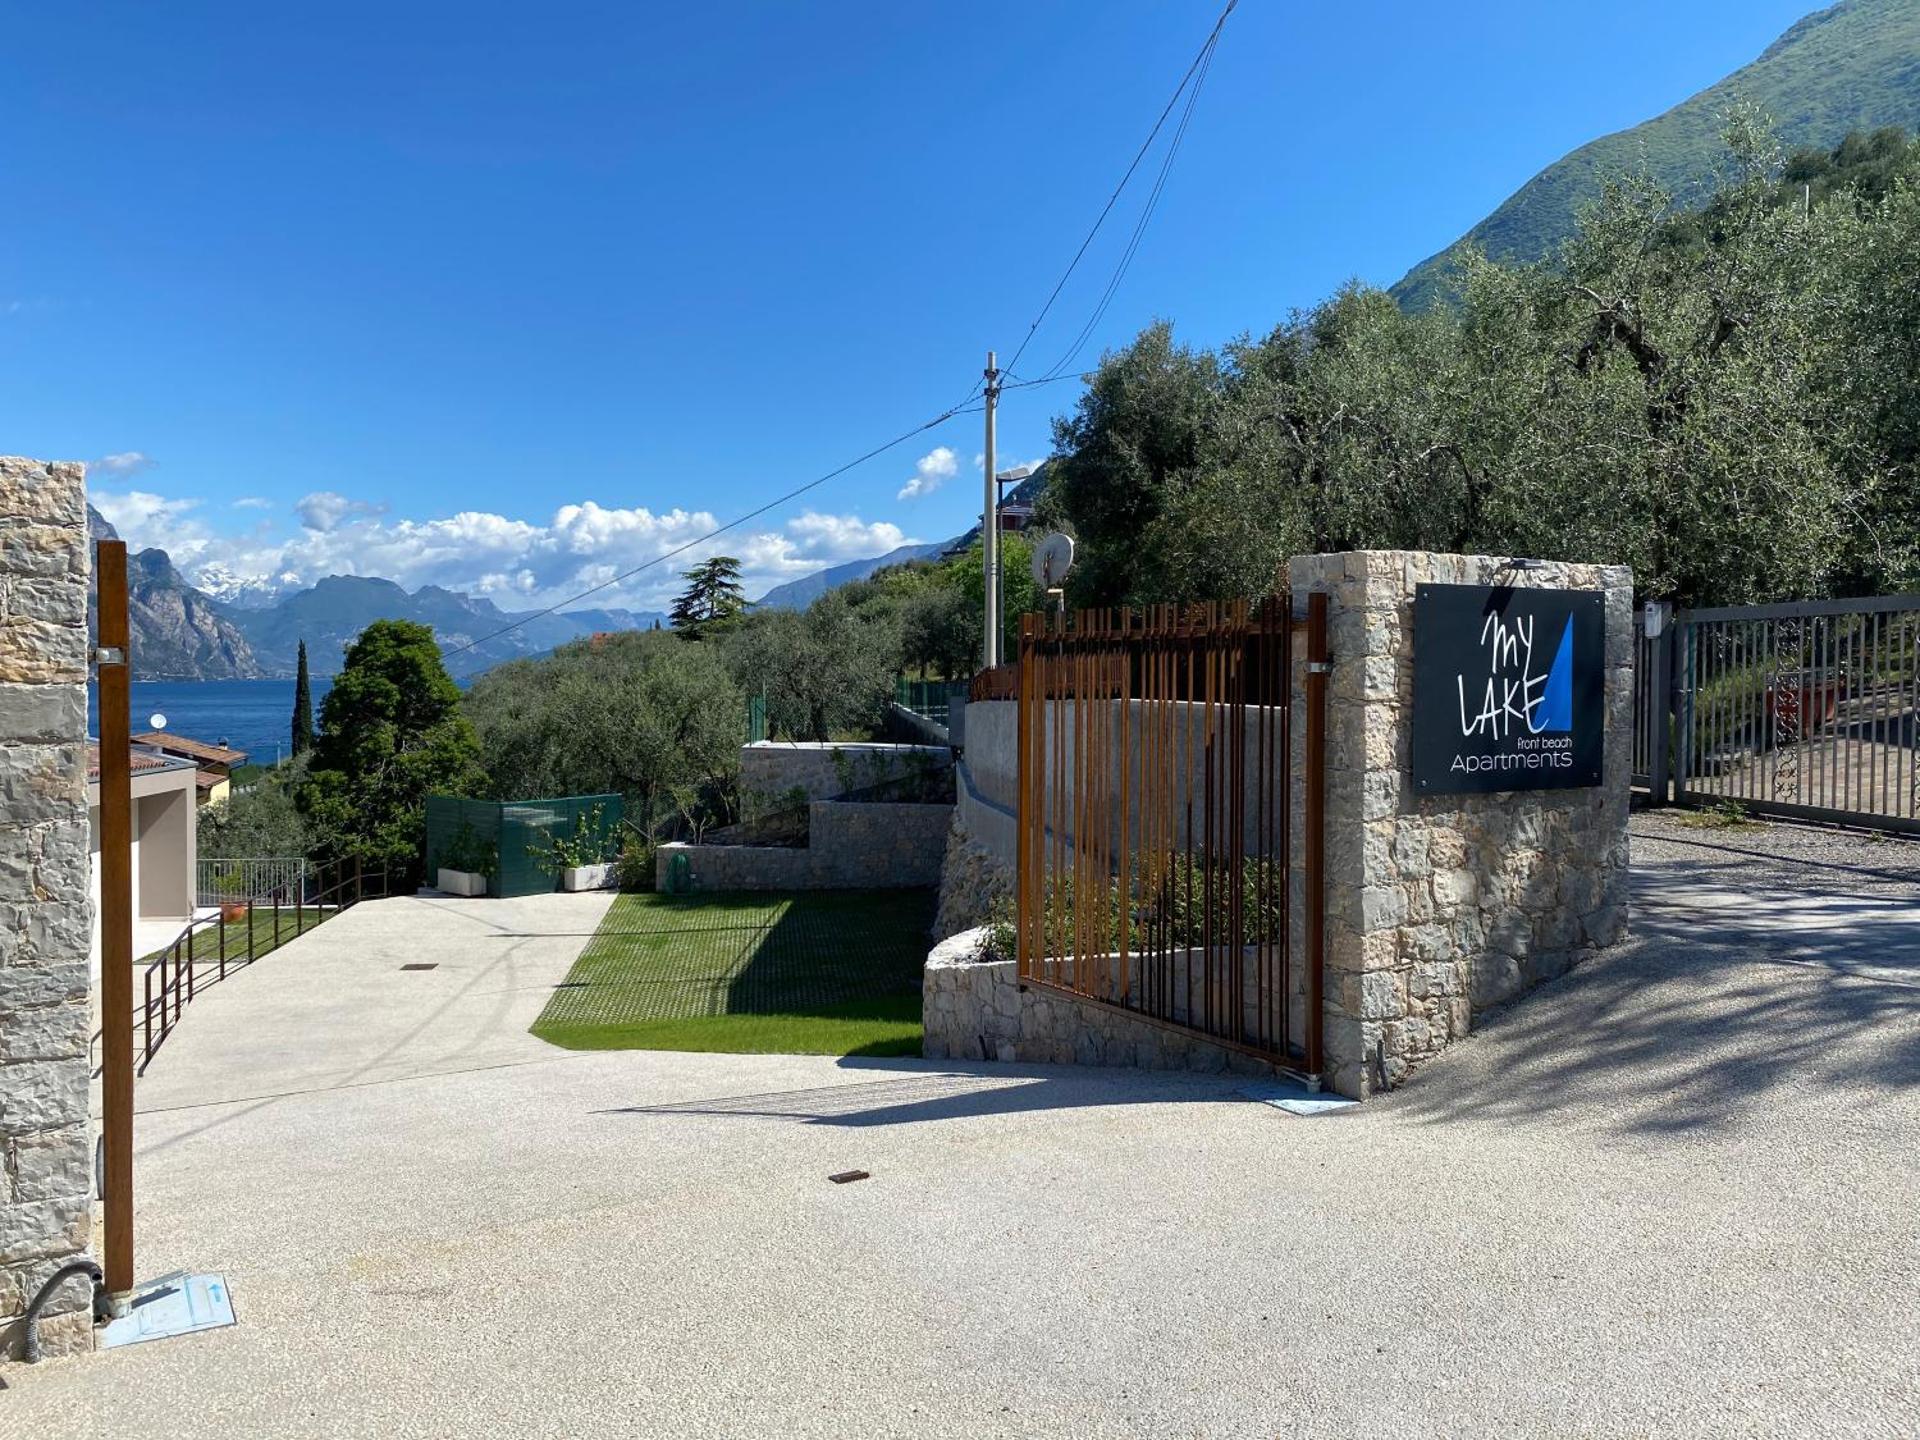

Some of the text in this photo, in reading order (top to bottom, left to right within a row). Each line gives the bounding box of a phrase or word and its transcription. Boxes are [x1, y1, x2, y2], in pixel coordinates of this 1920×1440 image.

[1457, 674, 1549, 740] LAKE
[1517, 736, 1572, 749] front beach
[1450, 751, 1573, 774] Apartments
